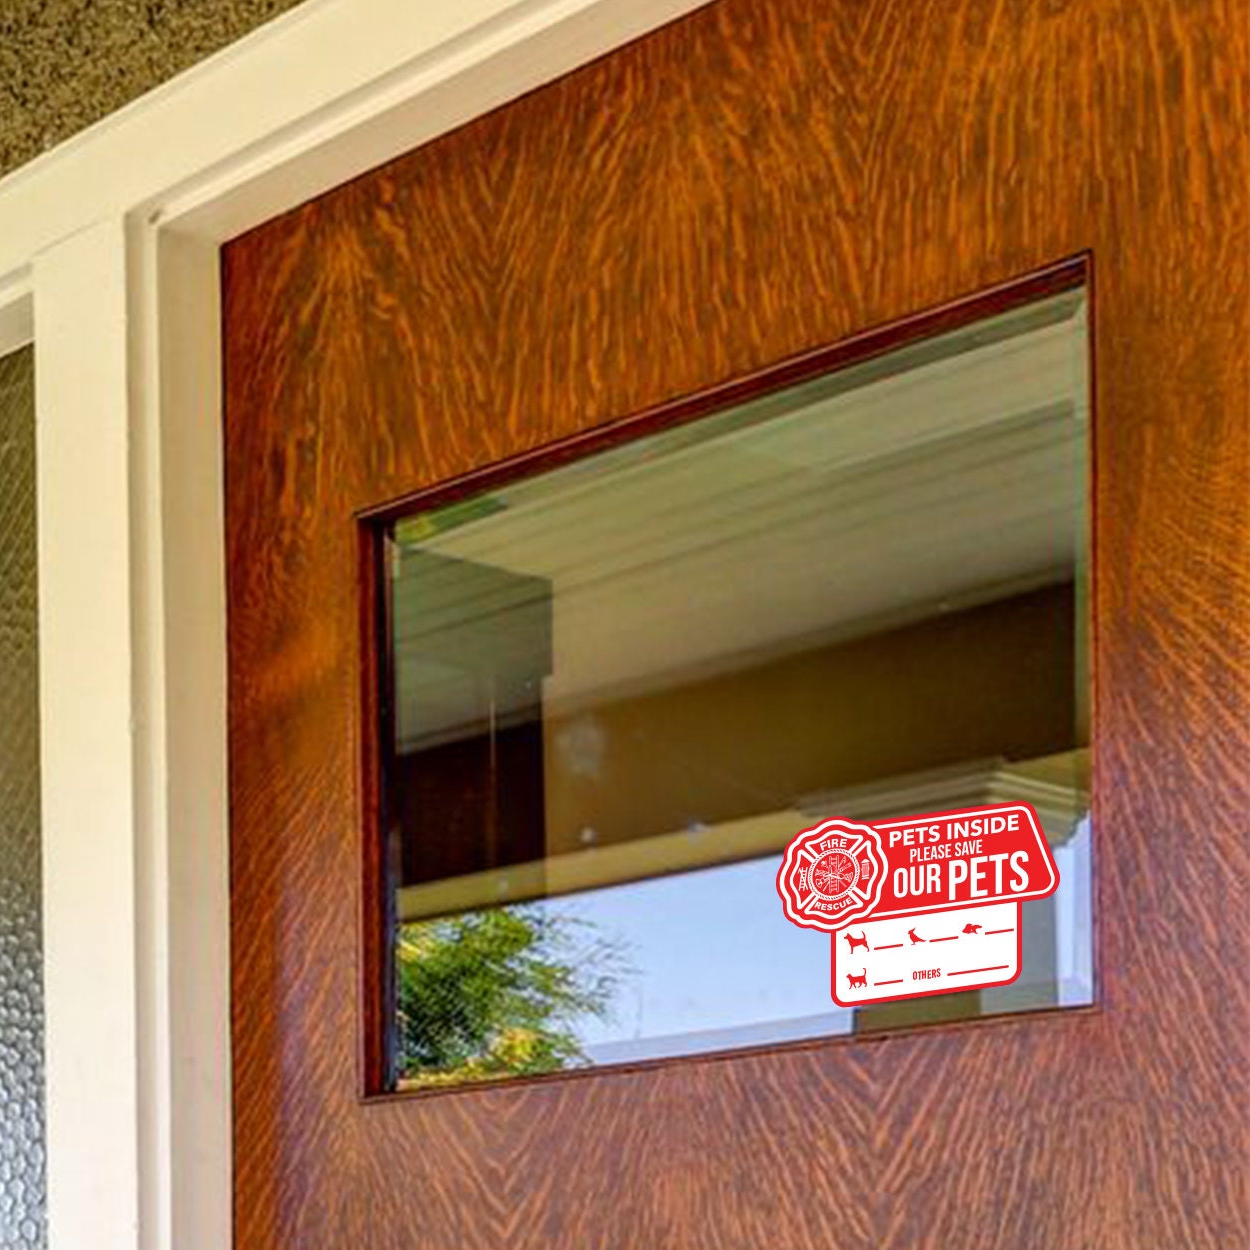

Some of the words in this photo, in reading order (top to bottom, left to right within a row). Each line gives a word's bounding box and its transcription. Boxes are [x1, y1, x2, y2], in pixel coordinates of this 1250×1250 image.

[889, 825, 941, 848] PETS
[947, 814, 1019, 840] INSIDE
[819, 838, 848, 851] FIRE
[910, 844, 951, 863] PLEASE
[954, 839, 982, 857] SAVE
[893, 863, 941, 898] OUR
[949, 850, 1029, 901] PETS
[814, 898, 853, 911] RESCUE
[912, 968, 941, 981] OTHERS
